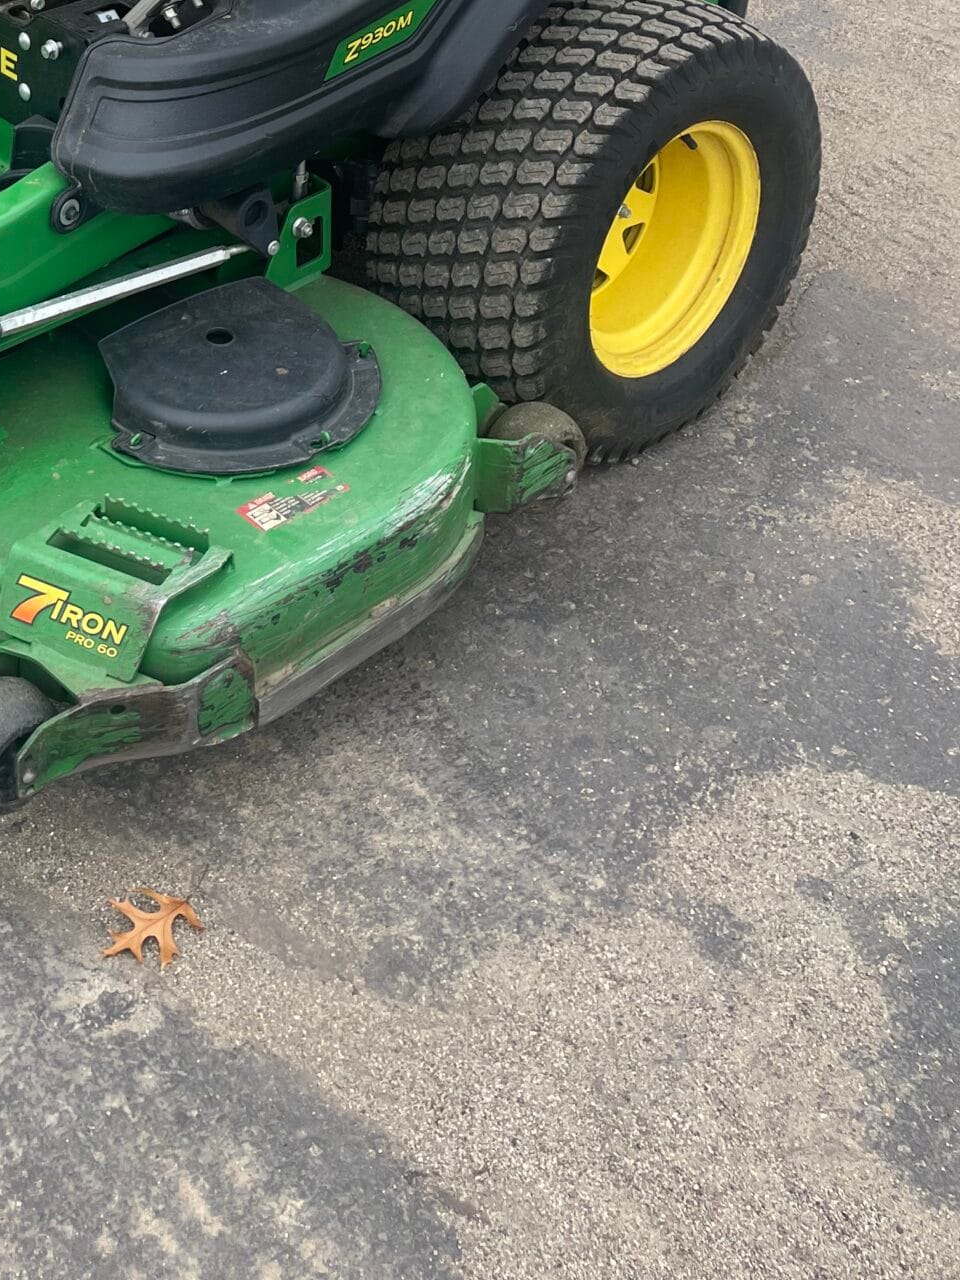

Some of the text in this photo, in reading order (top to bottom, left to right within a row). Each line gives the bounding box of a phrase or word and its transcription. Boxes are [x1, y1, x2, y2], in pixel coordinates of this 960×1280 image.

[344, 10, 414, 63] Z930M
[65, 630, 118, 658] PRO 60
